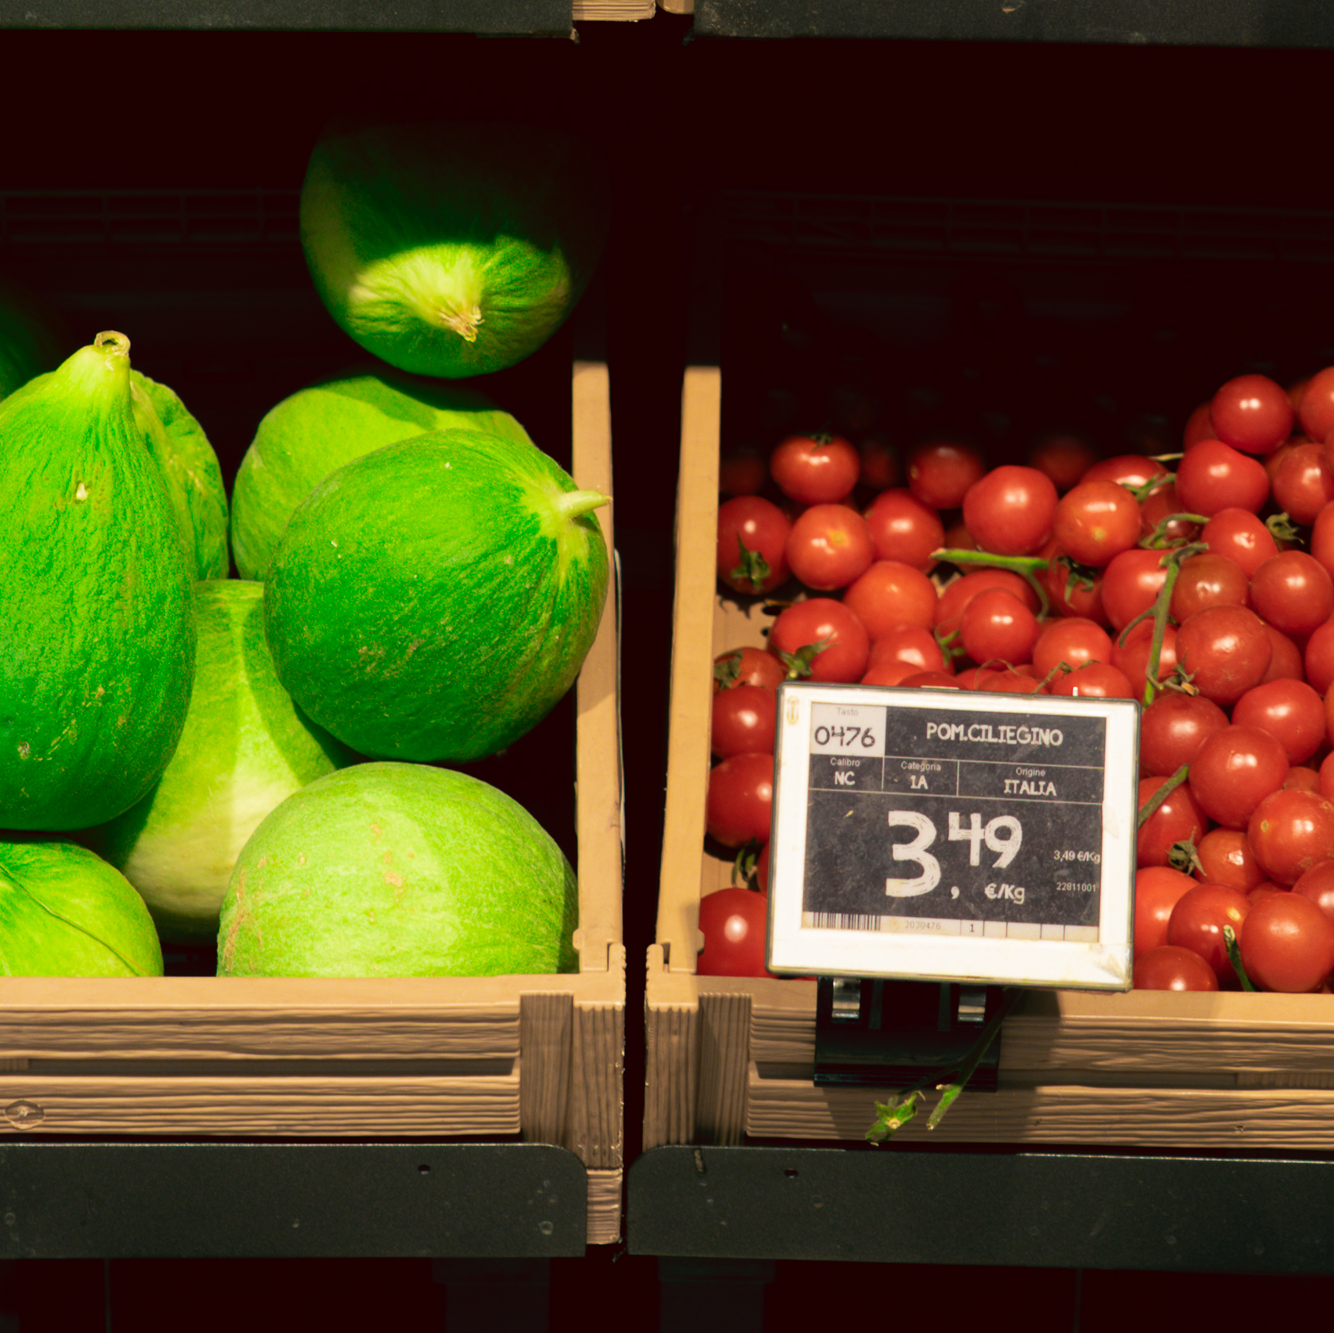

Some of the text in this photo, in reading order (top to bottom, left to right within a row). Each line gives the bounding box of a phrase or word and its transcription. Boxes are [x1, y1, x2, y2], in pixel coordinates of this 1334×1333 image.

[836, 707, 859, 717] Tasto
[814, 725, 876, 748] 0476
[926, 722, 1063, 746] POM.CILIEGINO
[830, 757, 861, 767] Calibro
[900, 760, 942, 772] Categoria
[834, 771, 855, 786] NC
[1015, 767, 1046, 778] Origine
[1003, 779, 1057, 797] ITALIA
[1053, 850, 1101, 864] 3,49 €/Kg
[1056, 881, 1097, 892] 22811001
[984, 883, 1026, 905] €/Kg
[904, 920, 942, 931] 2030476
[969, 923, 975, 933] 1
